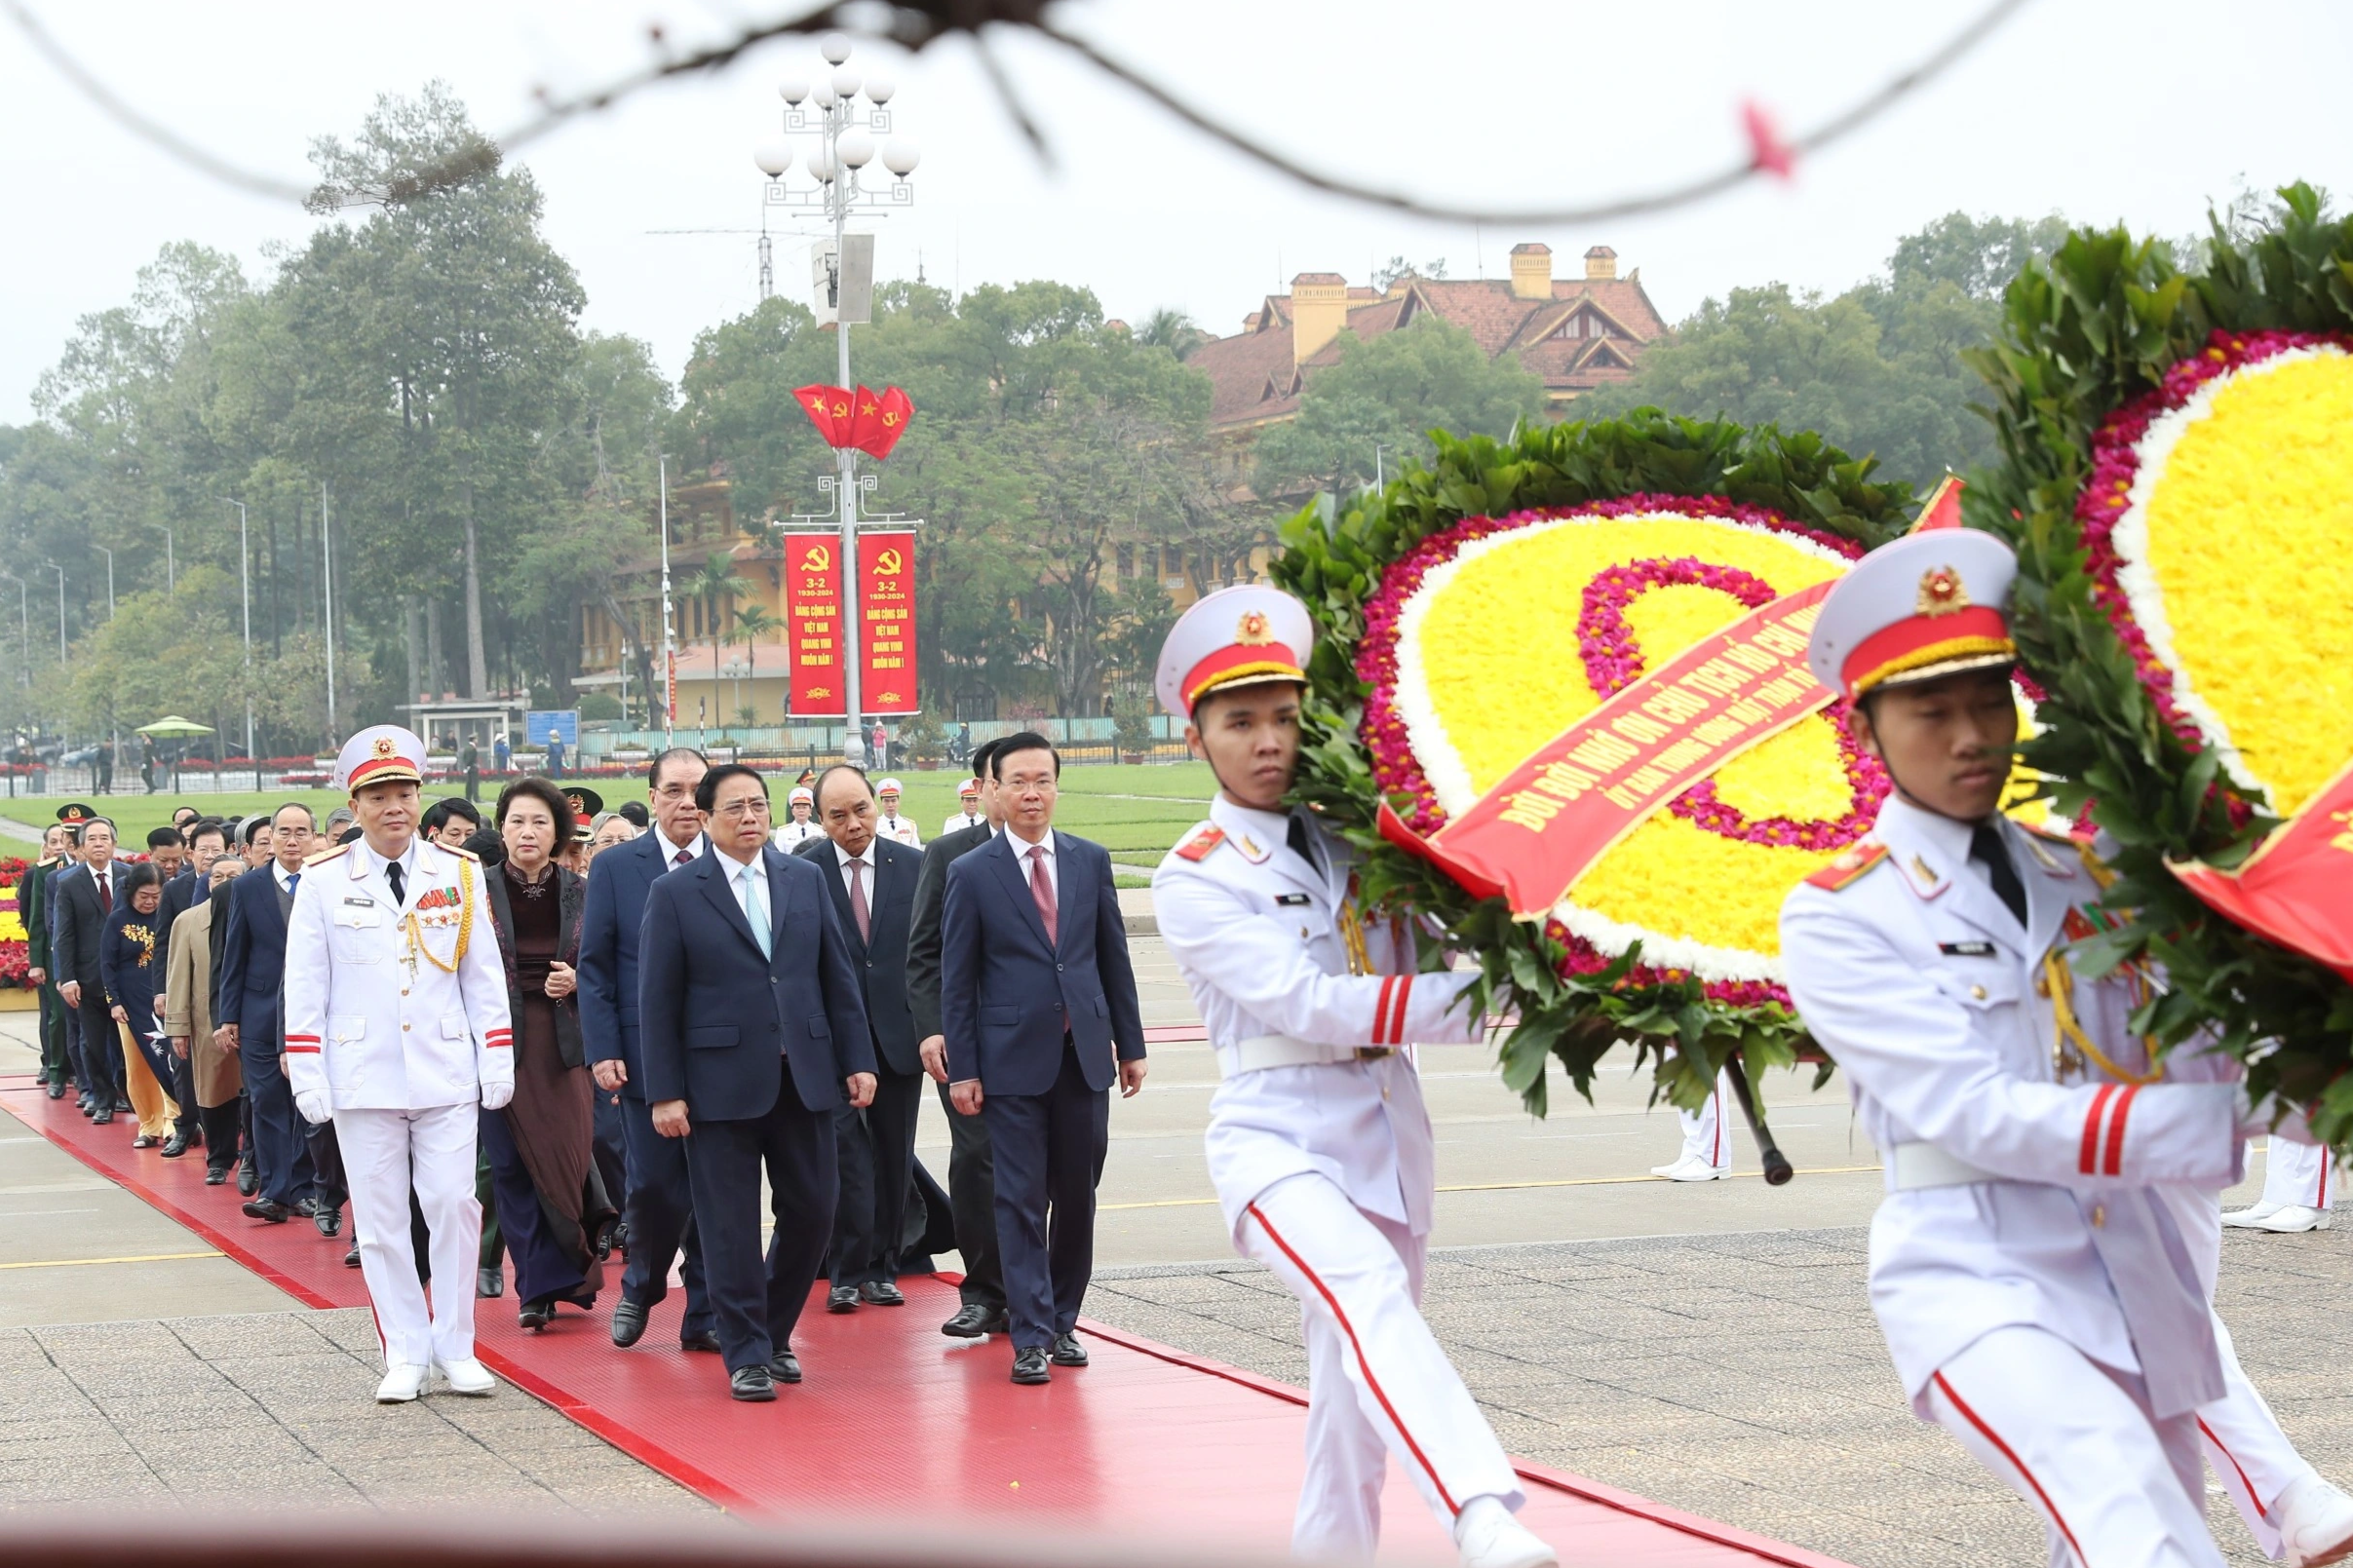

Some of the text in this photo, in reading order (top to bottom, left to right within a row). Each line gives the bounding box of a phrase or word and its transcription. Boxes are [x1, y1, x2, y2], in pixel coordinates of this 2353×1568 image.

[806, 577, 826, 589] 3-2
[877, 581, 897, 592] 3-2
[794, 600, 836, 619] ĐẢNG CỘNG SẢN
[867, 604, 908, 622] ĐẢNG CỘNG SẢN
[804, 620, 829, 635] VIỆT NAM
[875, 623, 900, 639] VIỆT NAM
[800, 637, 832, 650] QUANG VINH
[872, 641, 903, 654] QUANG VINH
[800, 652, 817, 666] MUÔN
[817, 652, 830, 666] NĂM
[872, 655, 888, 669] MUÔN
[888, 655, 901, 669] NĂM
[1498, 619, 1810, 833] ĐỜI ĐỜI NHỚ ƠN CHỦ TỊCH HỒ CHÍ
[1597, 784, 1643, 810] ỦY
[1622, 765, 1672, 796] BAN
[1649, 737, 1713, 774] TRUNG
[1690, 714, 1747, 747] ƯƠNG
[1724, 695, 1773, 723] MẶT
[1752, 677, 1806, 709] TRẬN
